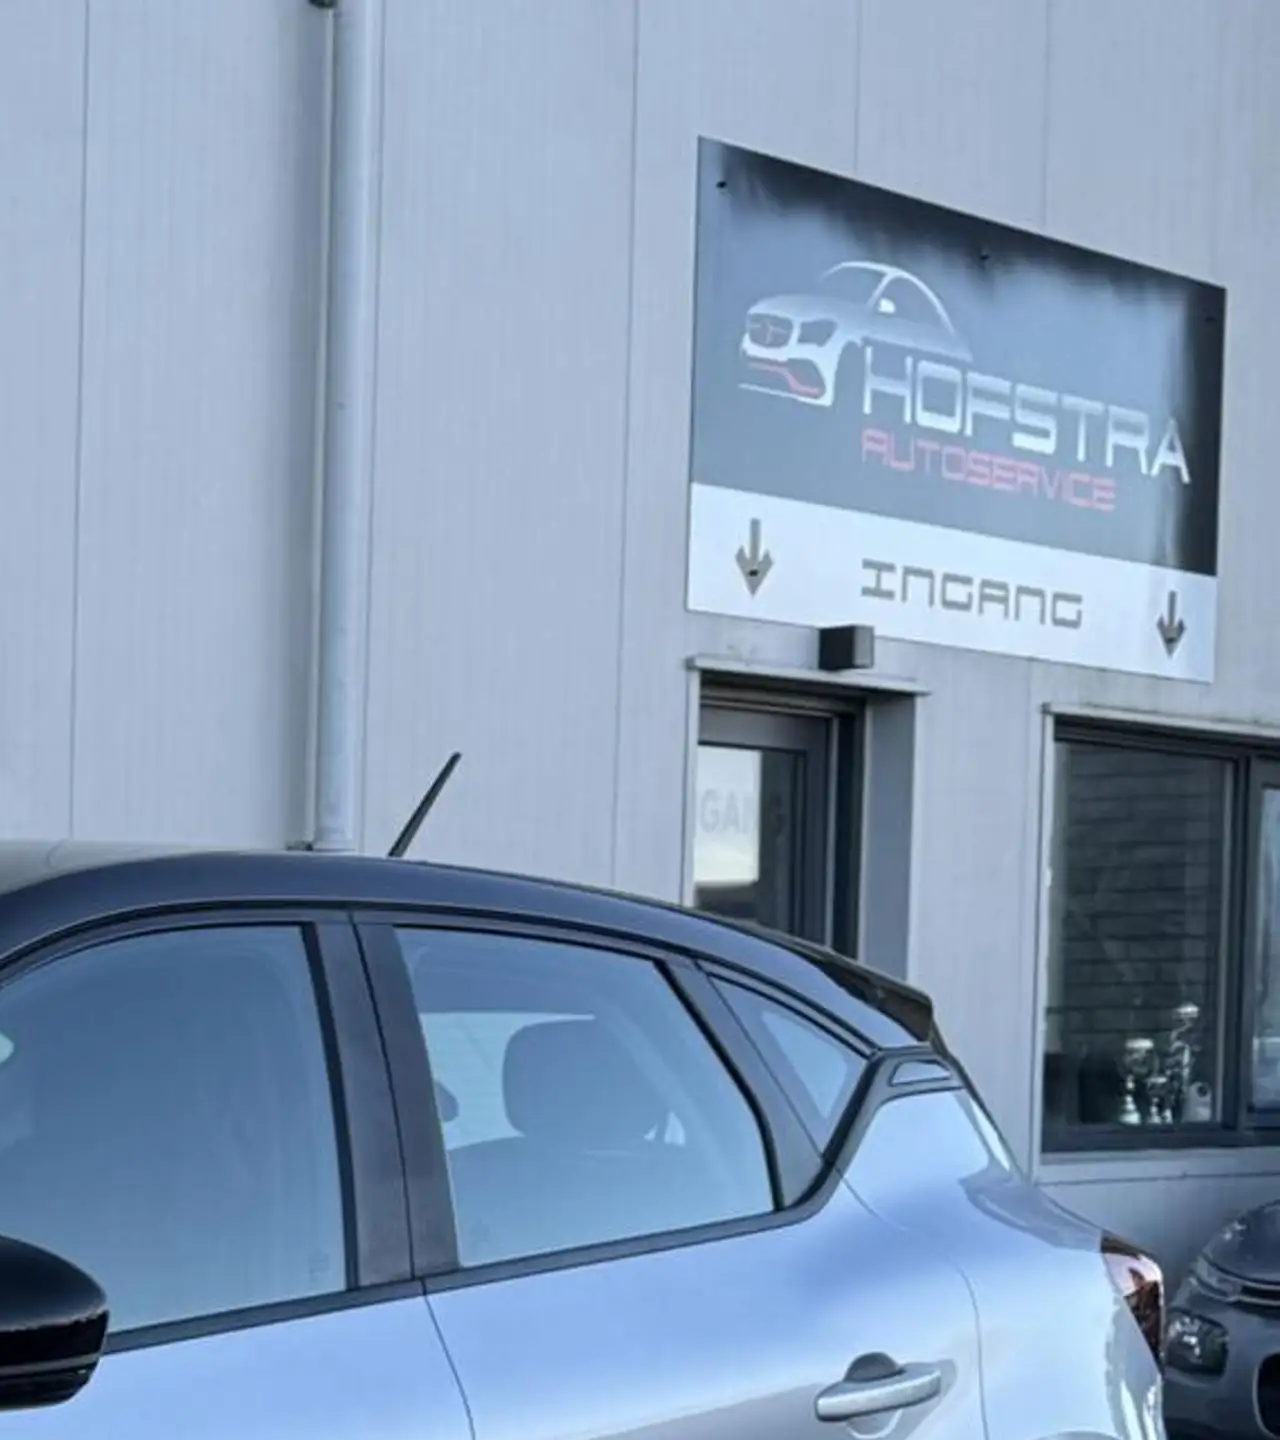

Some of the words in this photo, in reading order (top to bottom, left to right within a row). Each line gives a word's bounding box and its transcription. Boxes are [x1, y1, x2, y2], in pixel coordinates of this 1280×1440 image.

[862, 345, 1191, 485] HOFSTRA
[861, 427, 1117, 512] AUTOSERVICE
[860, 557, 1084, 630] INGANG
